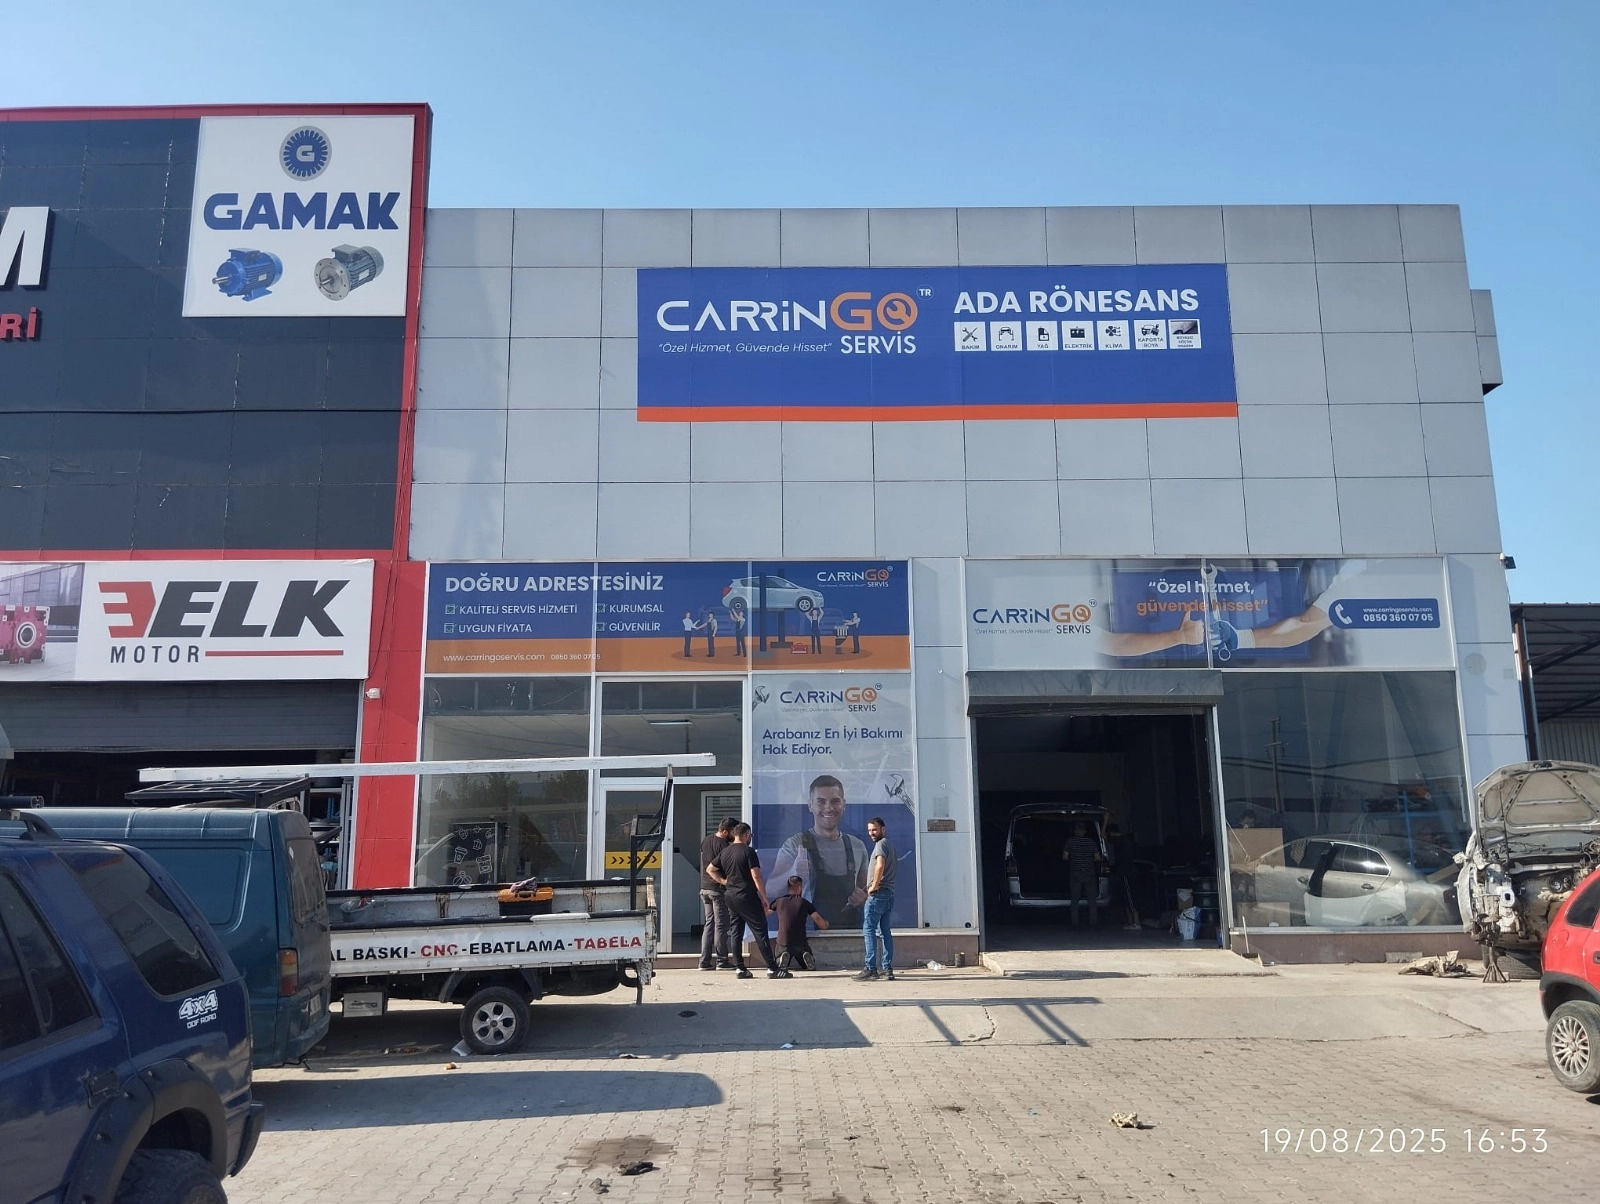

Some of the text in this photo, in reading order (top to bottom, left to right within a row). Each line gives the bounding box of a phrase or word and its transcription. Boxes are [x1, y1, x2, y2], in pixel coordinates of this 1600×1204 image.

[203, 191, 401, 231] GAMAK
[954, 284, 1199, 314] ADA RÖNESANS
[735, 342, 790, 352] Güvende
[840, 331, 917, 354] SERVİS
[445, 572, 664, 593] DOĞRU ADRESTESİNİZ
[459, 603, 578, 615] KALİTELİ SERVİS HİZMETİ
[610, 604, 664, 613] KURUMSAL
[1136, 599, 1208, 616] güvende
[1363, 614, 1388, 622] 0850
[1389, 614, 1406, 622] 360
[458, 622, 532, 634] UYGUN FİYATA
[608, 621, 661, 631] GÜVENİLİR
[1056, 622, 1091, 634] SERVİS
[110, 645, 200, 664] MOTOR
[443, 653, 545, 663] www.carringoservis.com
[848, 702, 876, 712] SERVİS
[762, 726, 903, 742] Arabanız En İyi Bakımı
[762, 744, 832, 757] Hak Ediyor.
